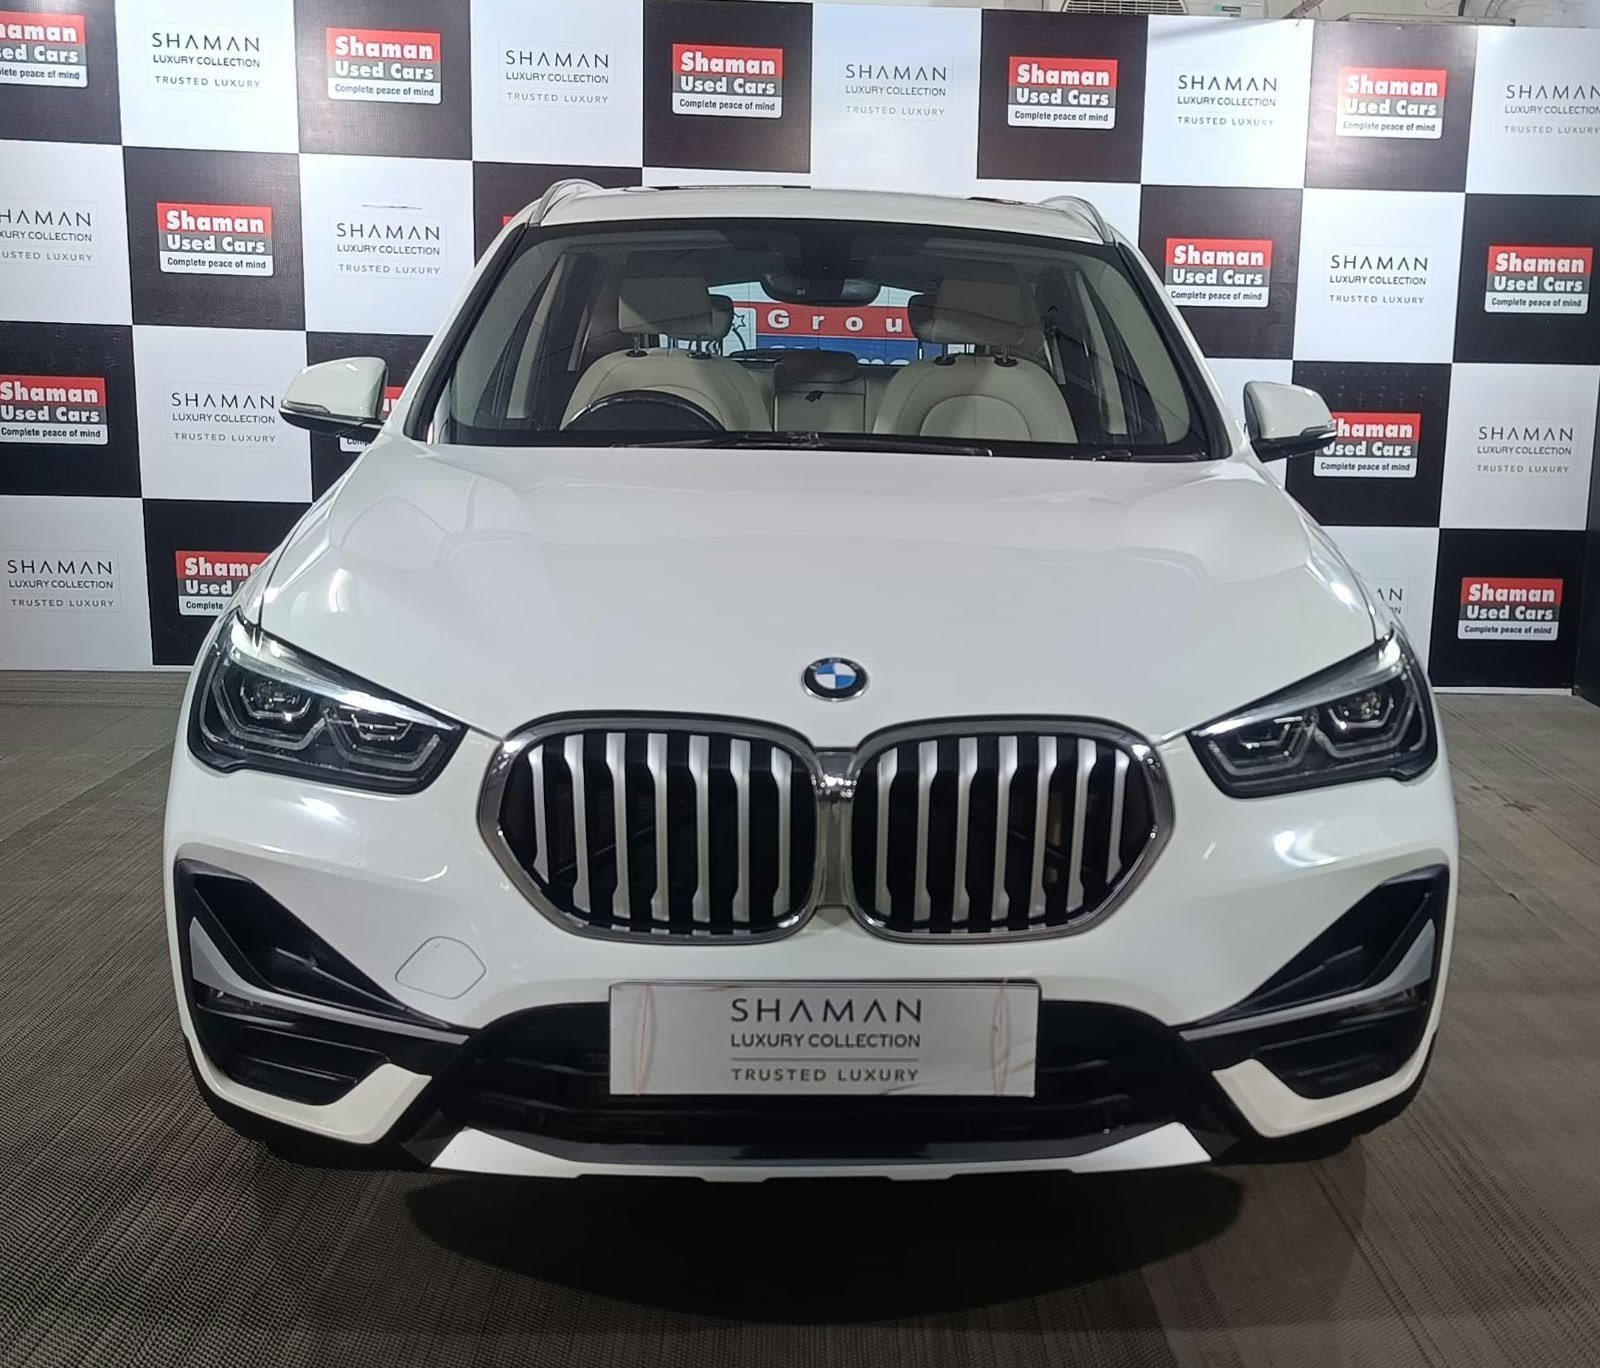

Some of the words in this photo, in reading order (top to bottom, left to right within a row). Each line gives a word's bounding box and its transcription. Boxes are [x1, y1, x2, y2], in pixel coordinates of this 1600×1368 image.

[0, 23, 78, 42] aman
[152, 32, 259, 52] SHAMAN
[335, 36, 433, 60] Shaman
[0, 43, 27, 60] ed
[34, 45, 79, 63] Cars
[506, 50, 609, 68] SHAMAN
[153, 54, 195, 65] LUXURY
[196, 56, 260, 68] COLLECTION
[681, 52, 775, 75] Shaman
[0, 67, 17, 77] lete
[20, 70, 45, 79] peace
[47, 70, 56, 78] of
[58, 71, 80, 80] mind
[335, 60, 384, 78] Used
[390, 63, 434, 80] Cars
[846, 64, 946, 81] SHAMAN
[1017, 64, 1109, 86] Shaman
[155, 76, 209, 86] TRUSTED
[215, 79, 261, 88] LUXURY
[506, 72, 546, 81] LUXURY
[547, 73, 609, 84] COLLECTION
[680, 75, 727, 93] Used
[733, 78, 775, 95] Cars
[1178, 75, 1277, 92] SHAMAN
[1345, 74, 1438, 96] Shaman
[335, 84, 374, 94] Complete
[376, 87, 401, 95] peace
[403, 87, 411, 95] of
[413, 88, 434, 96] mind
[845, 85, 885, 94] LUXURY
[886, 86, 946, 97] COLLECTION
[1016, 88, 1062, 104] Used
[1068, 89, 1109, 106] Cars
[1506, 84, 1600, 100] SHAMAN
[507, 92, 559, 102] TRUSTED
[564, 95, 608, 104] LUXURY
[679, 98, 717, 109] Complete
[719, 102, 743, 110] peace
[744, 102, 753, 110] of
[755, 103, 775, 111] mind
[1177, 96, 1216, 105] LUXURY
[1217, 97, 1276, 107] COLLECTION
[846, 105, 896, 114] TRUSTED
[902, 108, 945, 116] LUXURY
[1344, 98, 1391, 114] Used
[1396, 99, 1437, 116] Cars
[1505, 105, 1543, 114] LUXURY
[1014, 110, 1052, 121] Complete
[1053, 114, 1077, 122] peace
[1078, 113, 1087, 121] of
[1089, 114, 1109, 122] mind
[1177, 116, 1227, 125] TRUSTED
[1232, 118, 1275, 127] LUXURY
[1343, 121, 1379, 130] Complete
[1380, 123, 1404, 132] peace
[1406, 123, 1414, 131] of
[1416, 123, 1436, 131] mind
[1504, 125, 1553, 134] TRUSTED
[1558, 126, 1600, 134] LUXURY
[167, 210, 264, 233] Shaman
[28, 231, 92, 242] COLLECTION
[337, 223, 440, 241] SHAMAN
[167, 234, 216, 251] Used
[222, 236, 265, 253] Cars
[337, 244, 377, 253] LUXURY
[379, 245, 440, 256] COLLECTION
[47, 253, 93, 262] LUXURY
[1174, 245, 1264, 266] Shaman
[1495, 252, 1584, 273] Shaman
[167, 257, 206, 267] Complete
[208, 260, 233, 269] peace
[235, 260, 243, 268] of
[246, 261, 266, 269] mind
[339, 264, 390, 273] TRUSTED
[396, 266, 440, 275] LUXURY
[1331, 255, 1428, 271] SHAMAN
[1173, 268, 1218, 284] Used
[1223, 269, 1263, 285] Cars
[1330, 275, 1368, 284] LUXURY
[1369, 276, 1426, 285] COLLECTION
[1494, 276, 1539, 291] Used
[1543, 276, 1583, 292] Cars
[1171, 290, 1207, 300] Complete
[1208, 293, 1231, 301] peace
[1233, 292, 1241, 300] of
[1330, 294, 1378, 303] TRUSTED
[1383, 296, 1425, 304] LUXURY
[1491, 297, 1527, 307] Complete
[1529, 300, 1551, 308] peace
[1553, 299, 1561, 307] of
[1562, 299, 1582, 307] mind
[0, 381, 98, 403] Shaman
[172, 392, 275, 409] SHAMAN
[0, 405, 50, 421] Used
[56, 406, 100, 423] Cars
[172, 413, 212, 422] LUXURY
[214, 414, 275, 424] COLLECTION
[1, 427, 40, 437] Complete
[42, 430, 67, 438] peace
[69, 429, 78, 437] of
[80, 430, 101, 438] mind
[1333, 418, 1413, 438] haman
[1479, 426, 1573, 441] SHAMAN
[174, 432, 226, 441] TRUSTED
[232, 435, 276, 443] LUXURY
[1372, 441, 1411, 457] Cars
[1477, 446, 1514, 454] LUXURY
[1515, 446, 1572, 455] COLLECTION
[1320, 462, 1356, 471] Complete
[1357, 464, 1380, 472] peace
[1381, 463, 1390, 471] of
[7, 559, 112, 575] SHAMAN
[9, 580, 49, 588] LUXURY
[51, 580, 113, 589] COLLECTION
[185, 580, 232, 595] Used
[1468, 583, 1555, 602] Shaman
[11, 599, 64, 607] TRUSTED
[186, 601, 223, 610] Complete
[1467, 605, 1510, 619] Used
[1515, 606, 1553, 620] Cars
[1464, 625, 1499, 634] Complete
[1500, 627, 1523, 635] peace
[1524, 626, 1532, 634] of
[732, 998, 921, 1023] SHAMAN
[731, 1034, 804, 1048] LUXURY
[808, 1034, 920, 1048] COLLECTION
[732, 1068, 827, 1081] TRUSTED
[838, 1069, 919, 1081] LUXURY
